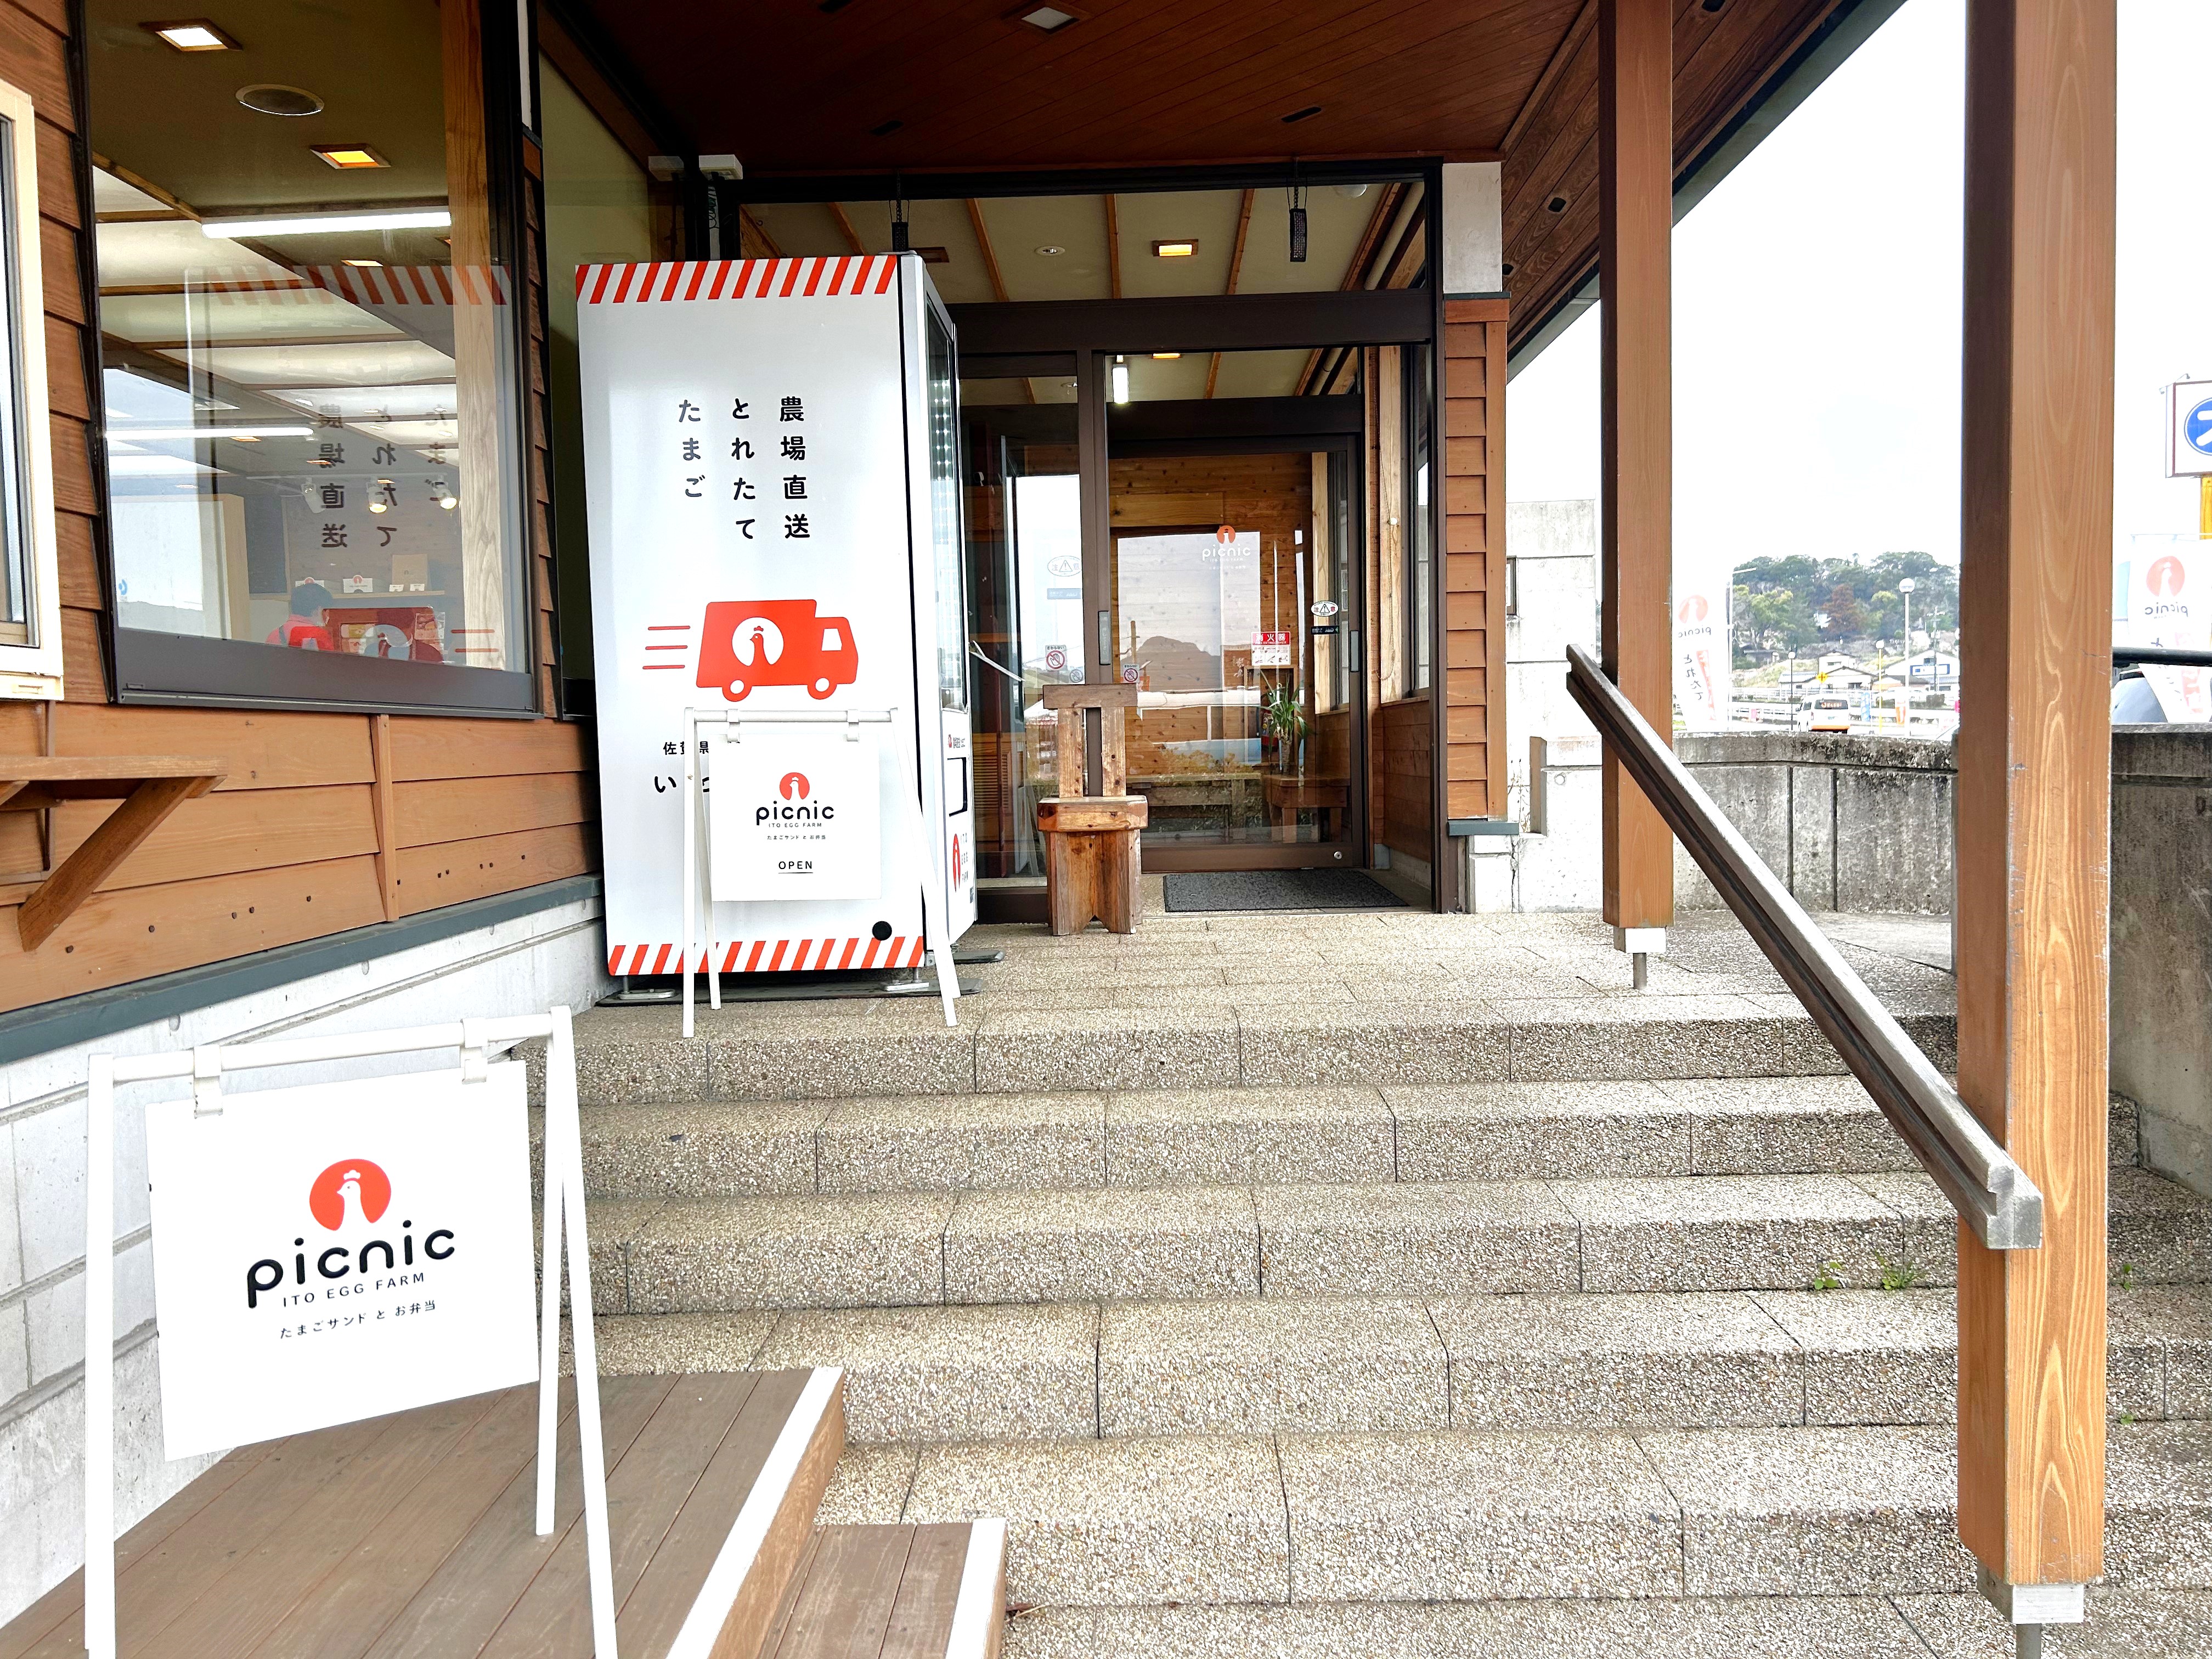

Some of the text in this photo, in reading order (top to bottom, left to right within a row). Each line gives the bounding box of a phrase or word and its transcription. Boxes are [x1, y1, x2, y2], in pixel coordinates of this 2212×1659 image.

[679, 399, 706, 498] たまご
[731, 398, 756, 539] とれたて
[780, 396, 810, 539] 農場直送
[1202, 543, 1251, 561] picnic
[756, 800, 834, 826] picnic
[778, 861, 812, 870] OPEN
[247, 1220, 455, 1309] picnic
[283, 1272, 425, 1307] ITO EGG FARM
[280, 1299, 436, 1339] たまごサンド と お弁当
